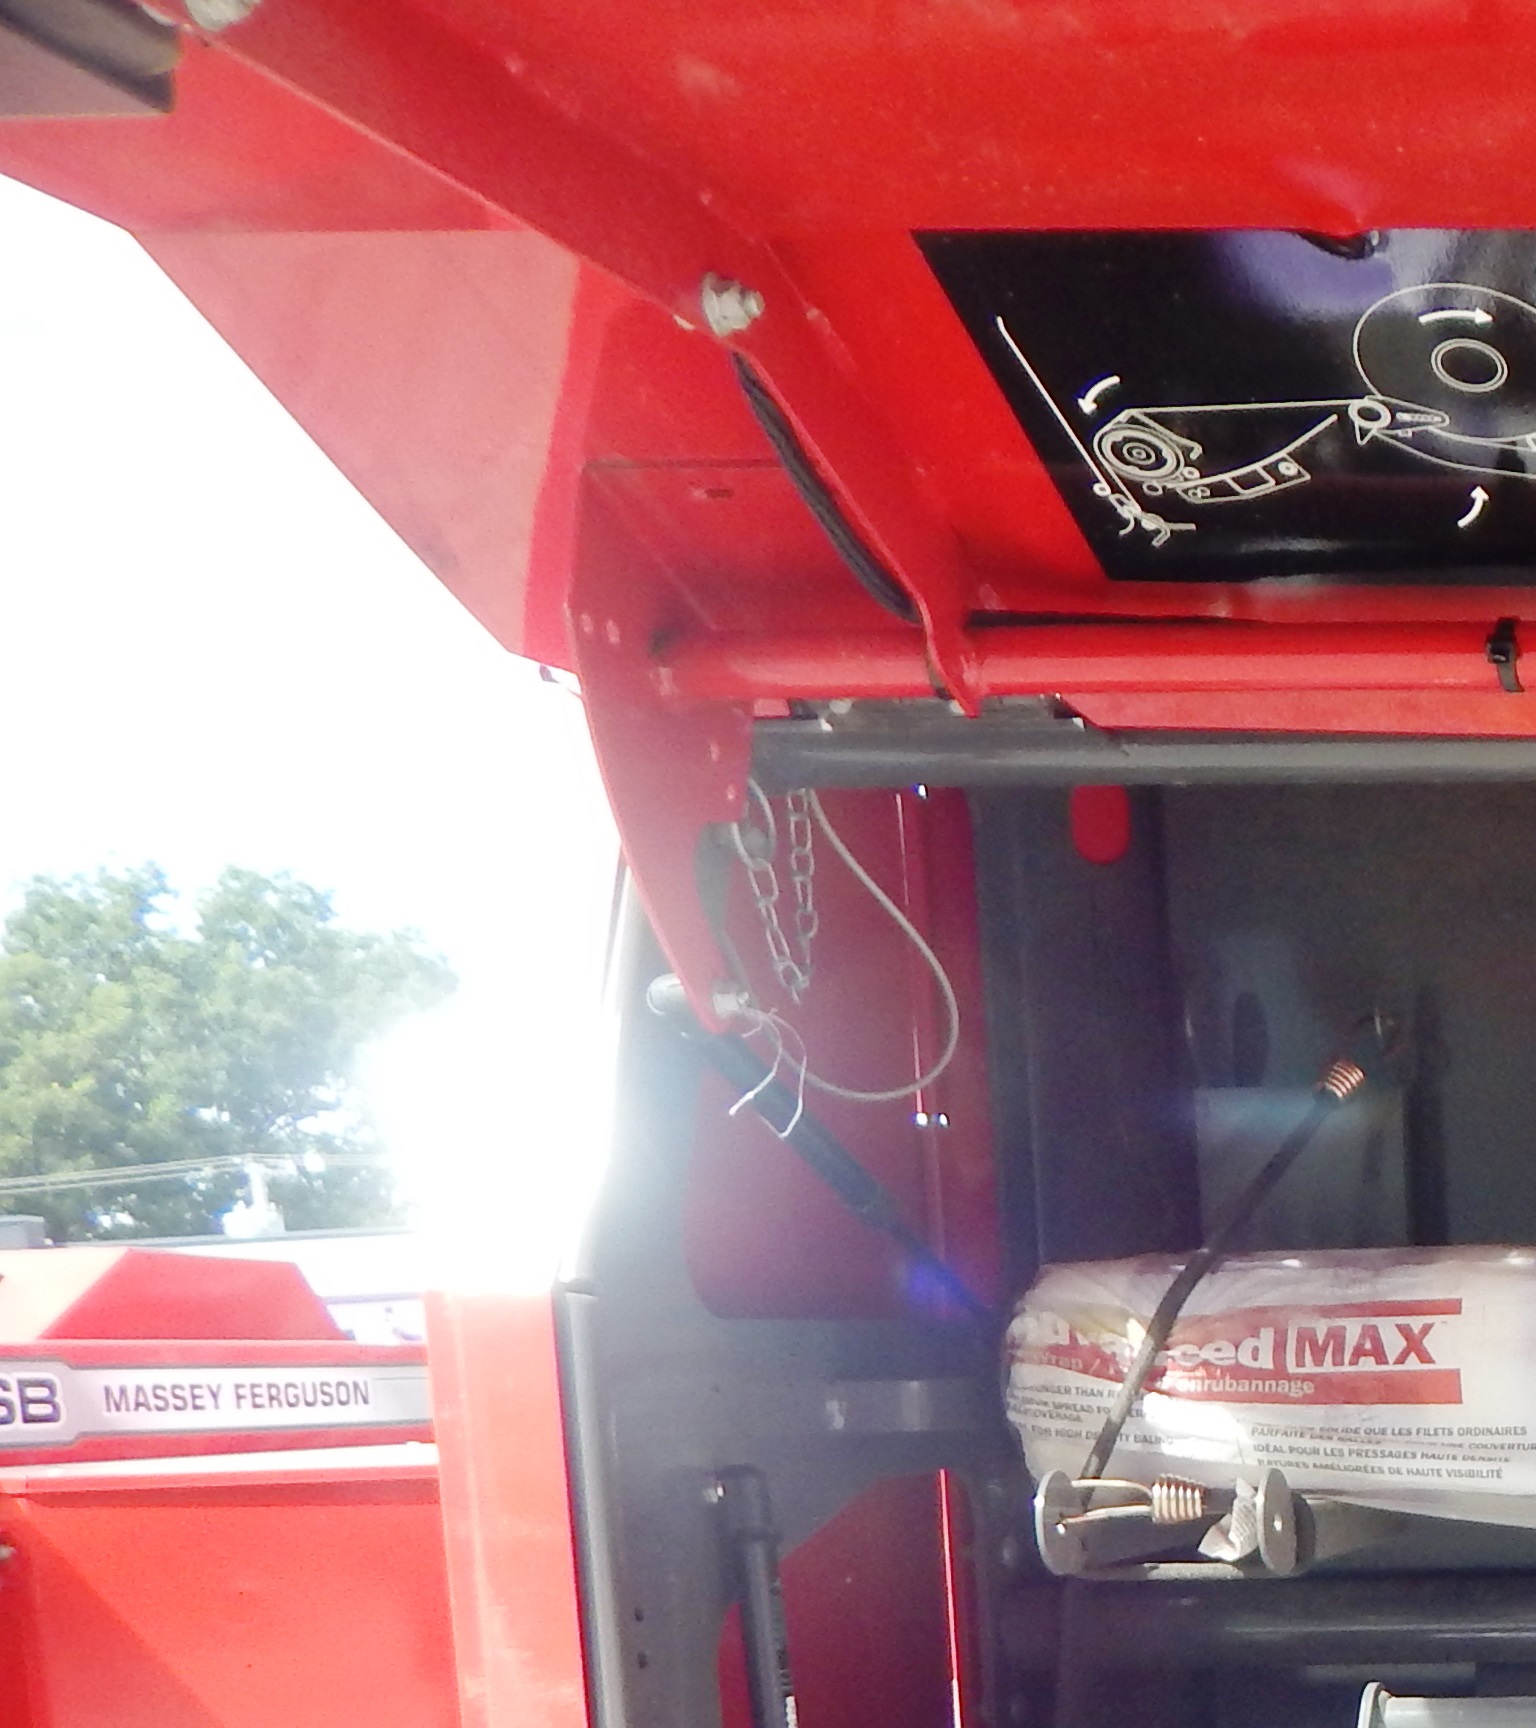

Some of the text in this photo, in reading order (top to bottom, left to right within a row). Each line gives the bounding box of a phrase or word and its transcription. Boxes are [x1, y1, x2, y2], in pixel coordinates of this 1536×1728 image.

[1295, 1321, 1436, 1368] MAX
[104, 1380, 370, 1413] MASSEY FERGUSON
[1364, 1426, 1388, 1436] QUE
[1391, 1426, 1413, 1436] LES
[1416, 1426, 1454, 1437] FILETS
[1457, 1426, 1527, 1437] ORDINAIRES
[1323, 1446, 1345, 1457] LES
